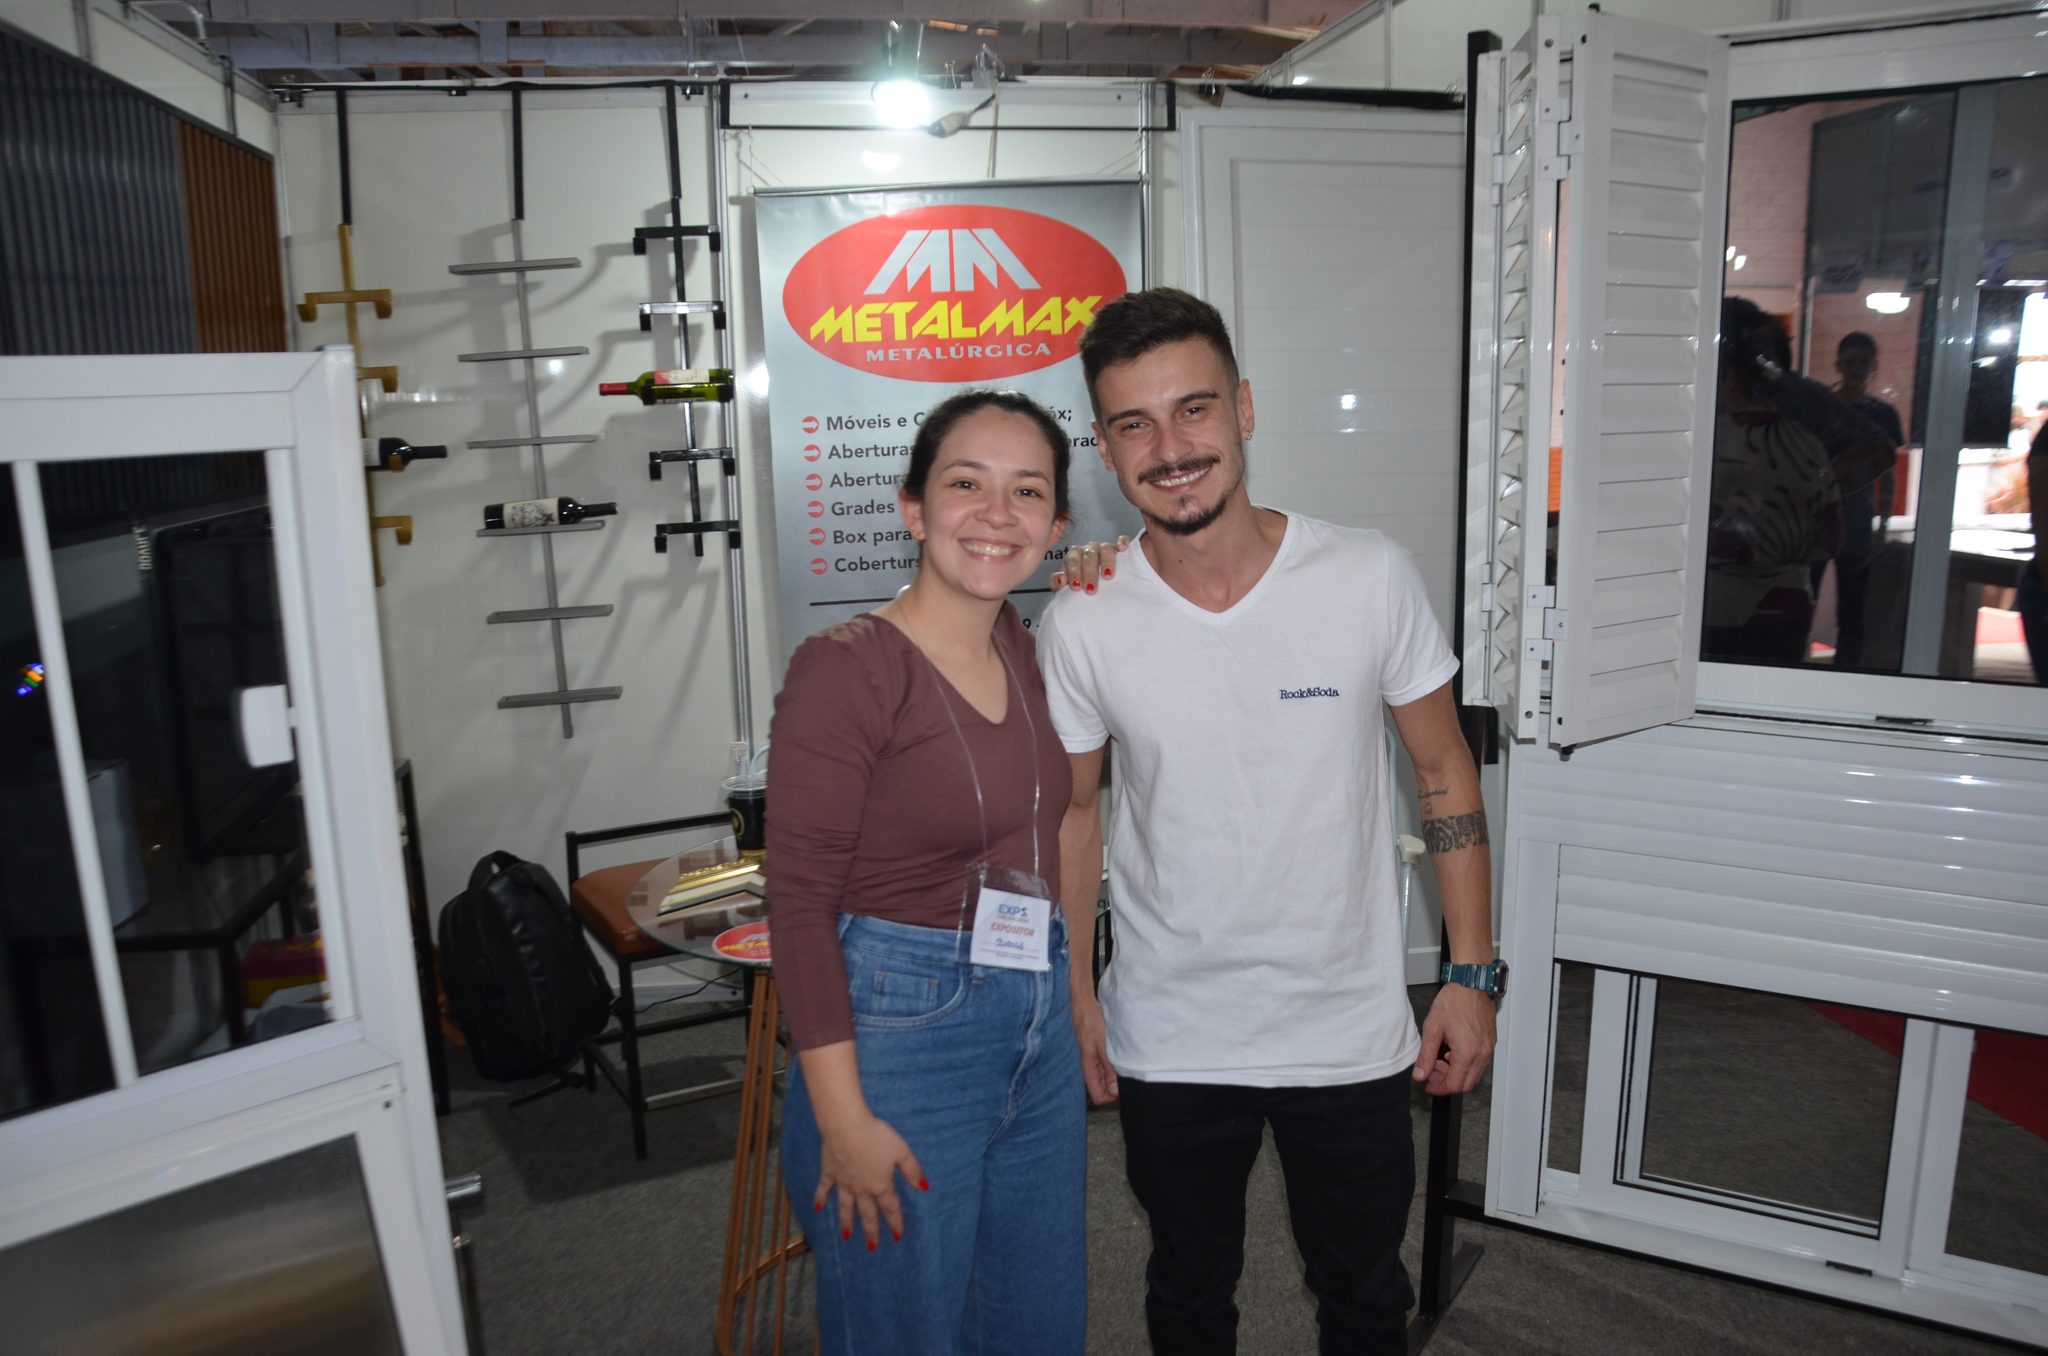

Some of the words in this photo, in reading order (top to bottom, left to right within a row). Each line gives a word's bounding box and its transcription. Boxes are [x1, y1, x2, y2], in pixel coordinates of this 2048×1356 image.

[810, 295, 1102, 344] METALMAX
[866, 342, 1051, 361] METALÚRGICA
[826, 413, 891, 431] Móveis
[896, 416, 907, 427] e
[831, 499, 895, 516] Grades
[833, 530, 867, 544] Box
[873, 529, 912, 546] para
